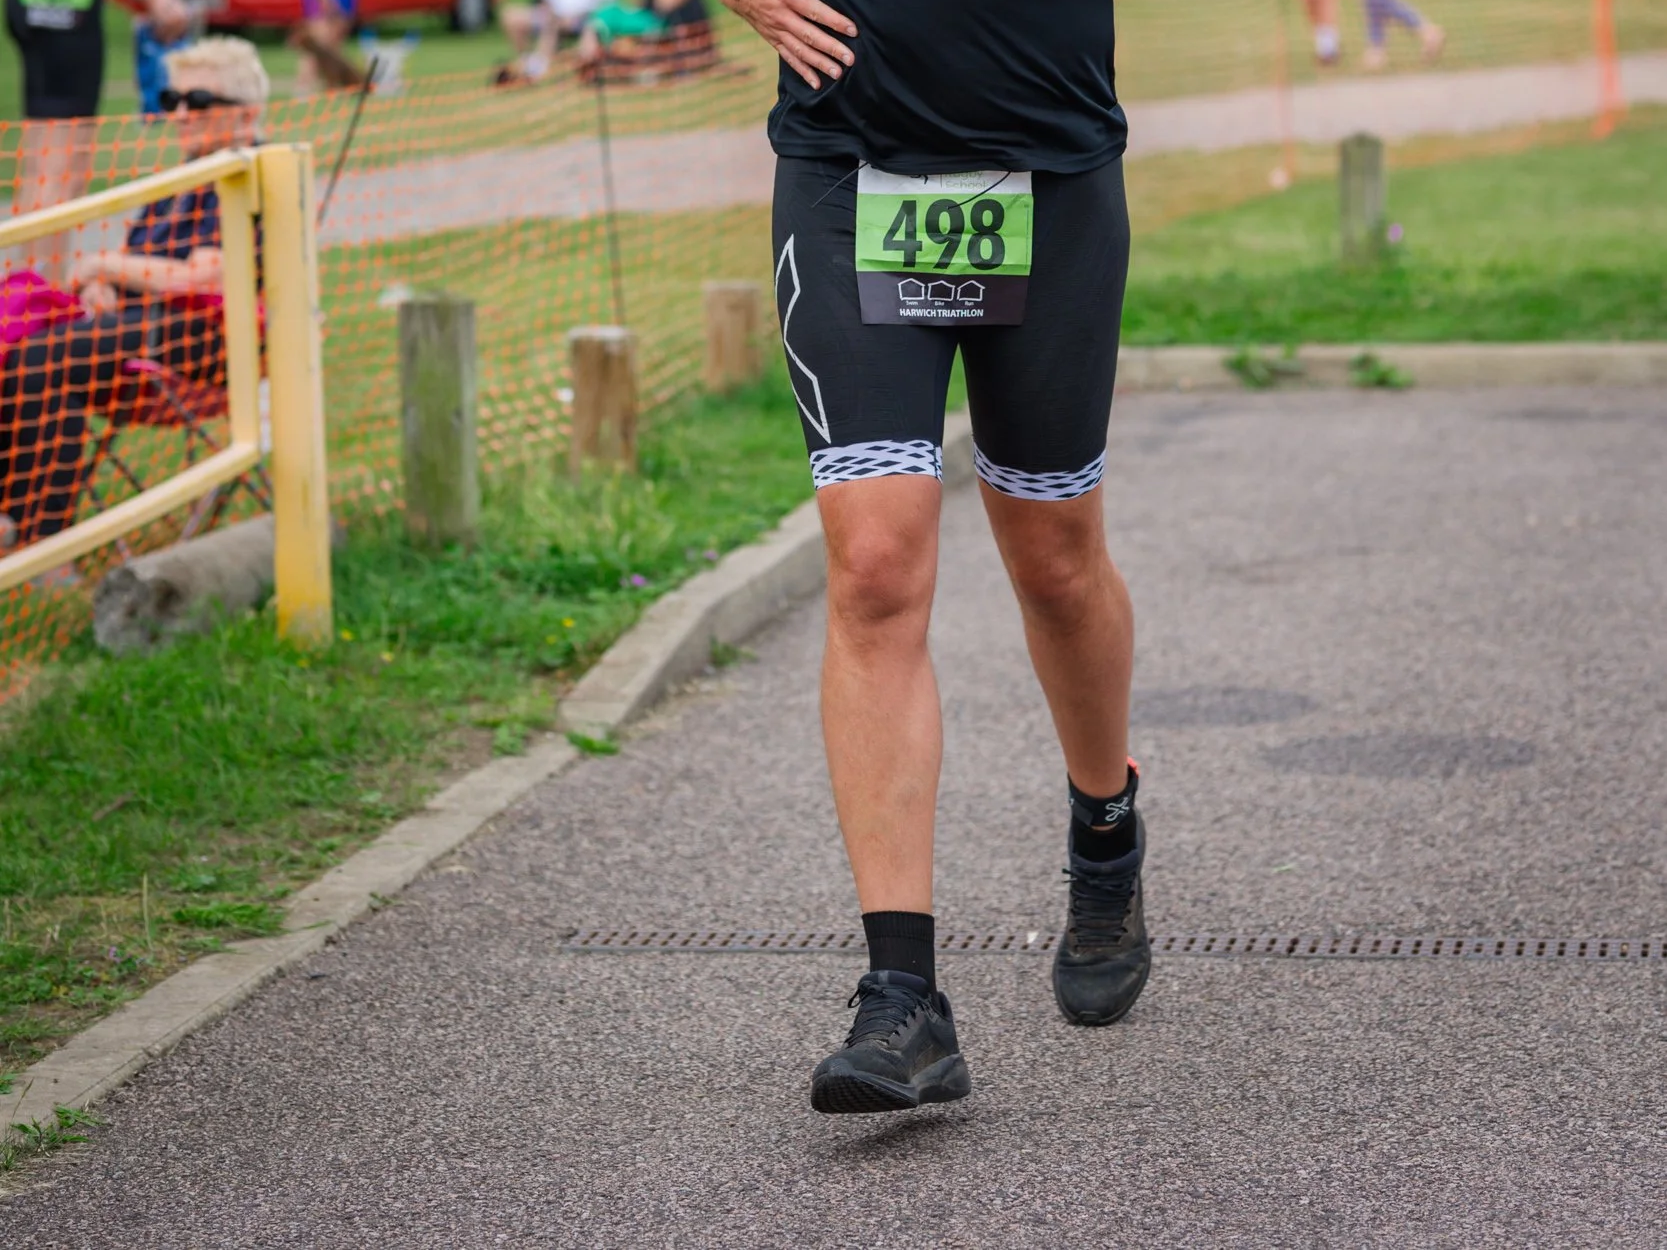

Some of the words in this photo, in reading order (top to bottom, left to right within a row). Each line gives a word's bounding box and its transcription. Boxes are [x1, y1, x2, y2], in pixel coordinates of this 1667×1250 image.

[882, 199, 1006, 270] 498
[899, 308, 936, 318] HARWICH
[937, 309, 984, 318] TRIATHLON
